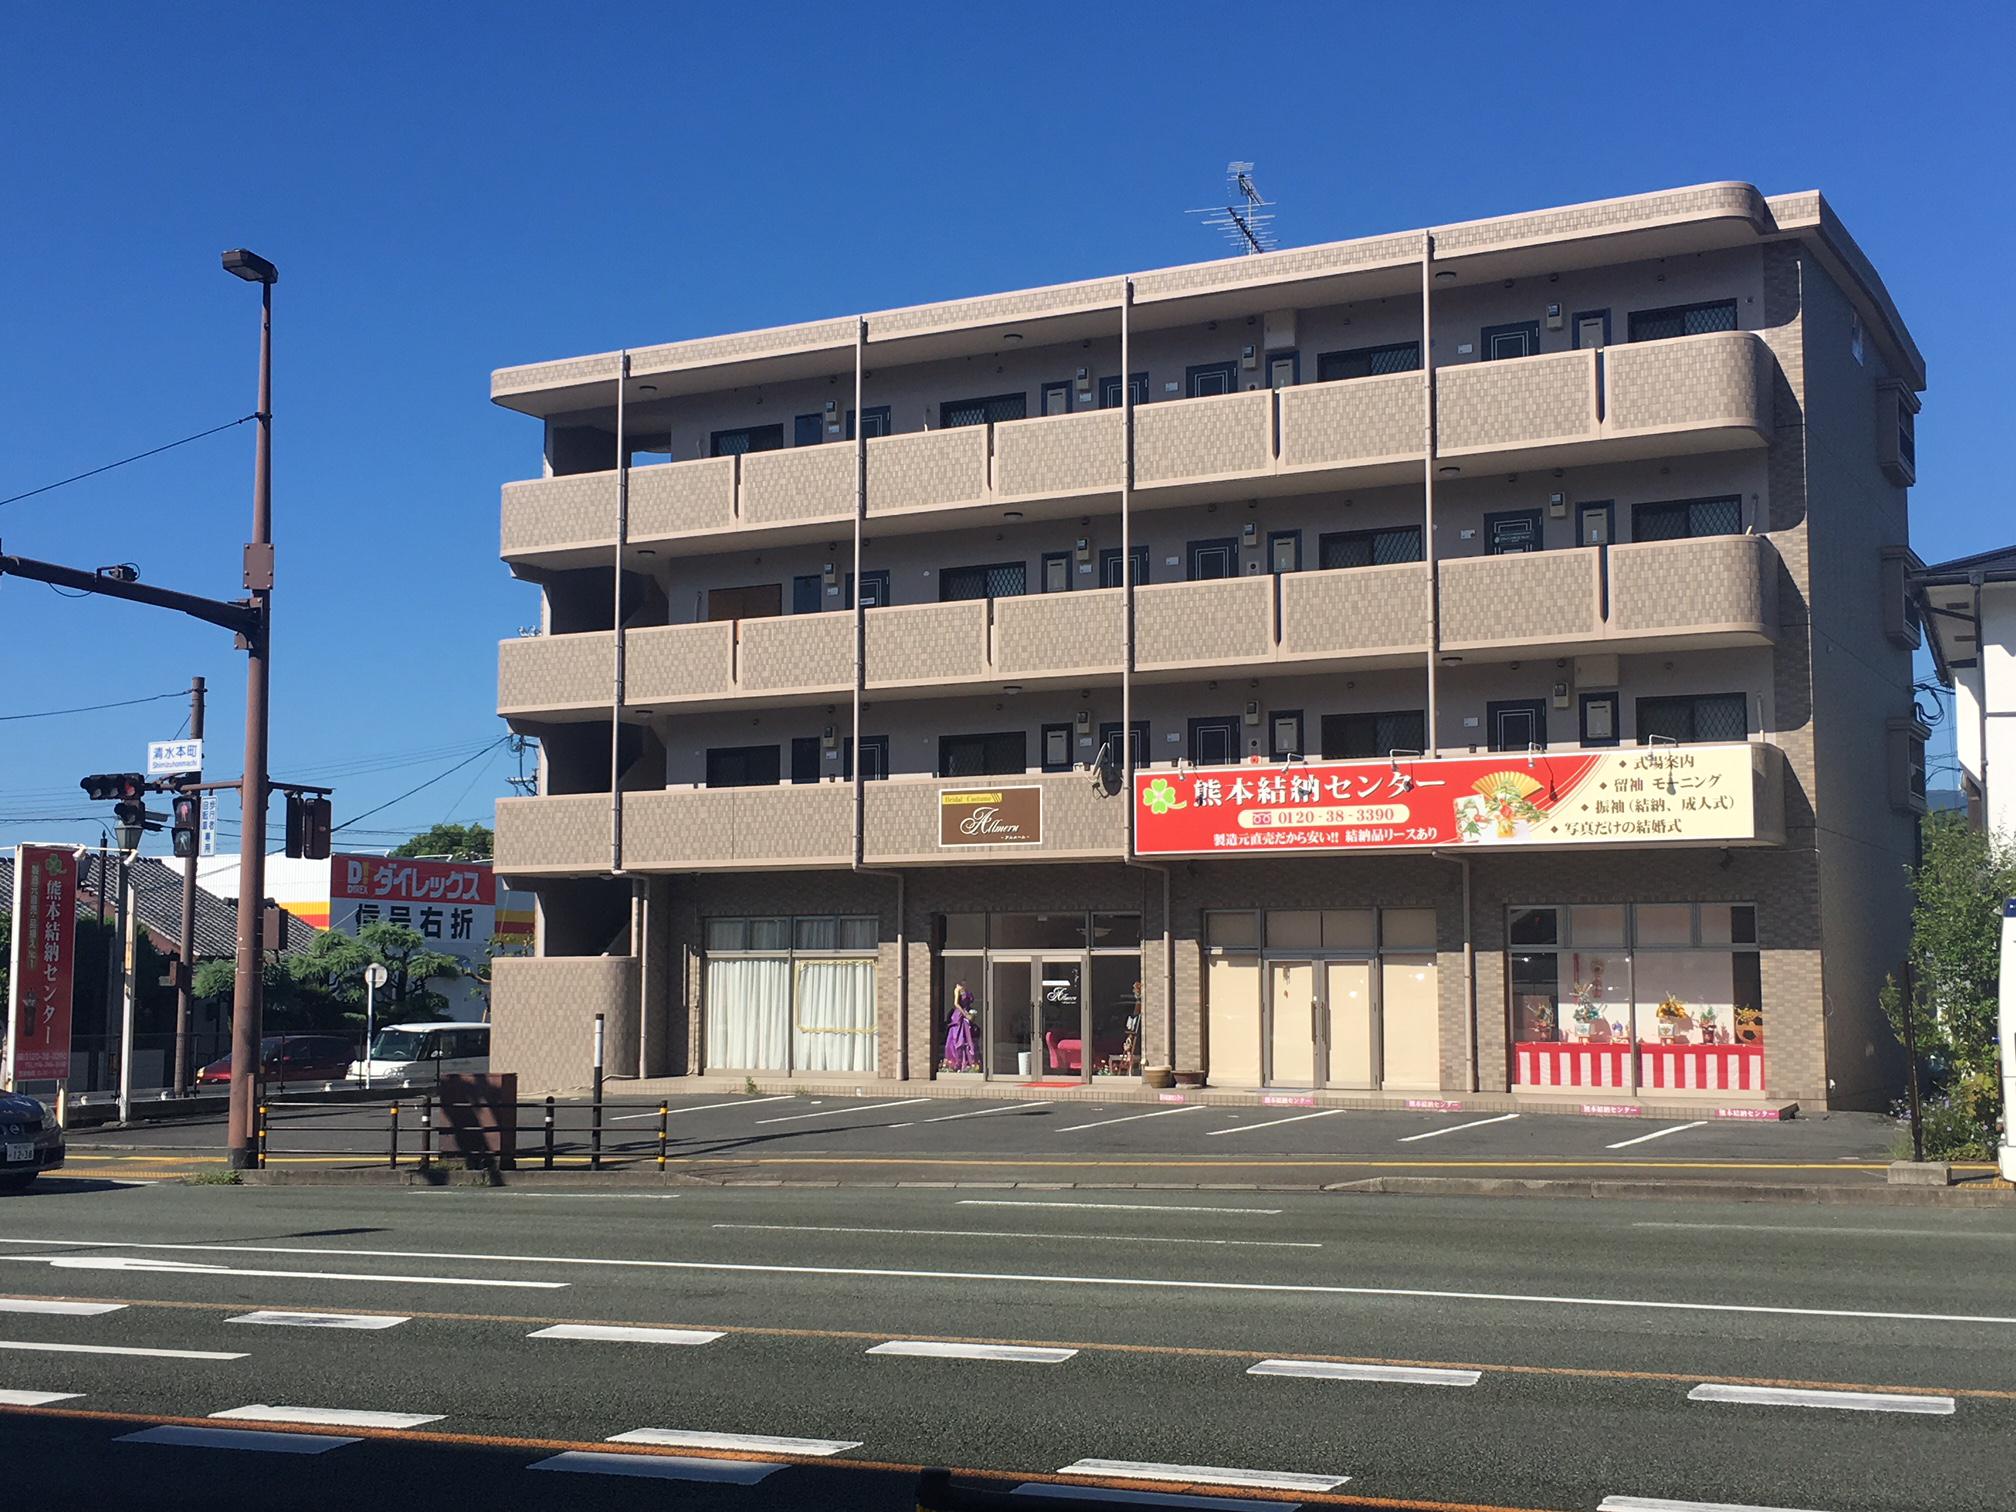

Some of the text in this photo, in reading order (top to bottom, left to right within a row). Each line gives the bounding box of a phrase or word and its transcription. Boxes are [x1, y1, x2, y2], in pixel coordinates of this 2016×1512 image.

[154, 745, 197, 759] 清水本町
[1634, 754, 1694, 770] 式場案内
[1193, 772, 1447, 807] 熊本結納センター
[1614, 774, 1722, 792] 留袖 モーニング
[1278, 809, 1394, 825] 0120-38-3390
[1345, 827, 1438, 843] 結納品リースあり
[1565, 819, 1682, 836] 写真だけの結婚式
[373, 863, 480, 900] ダイレックス
[43, 880, 62, 1044] 熊本結納センター
